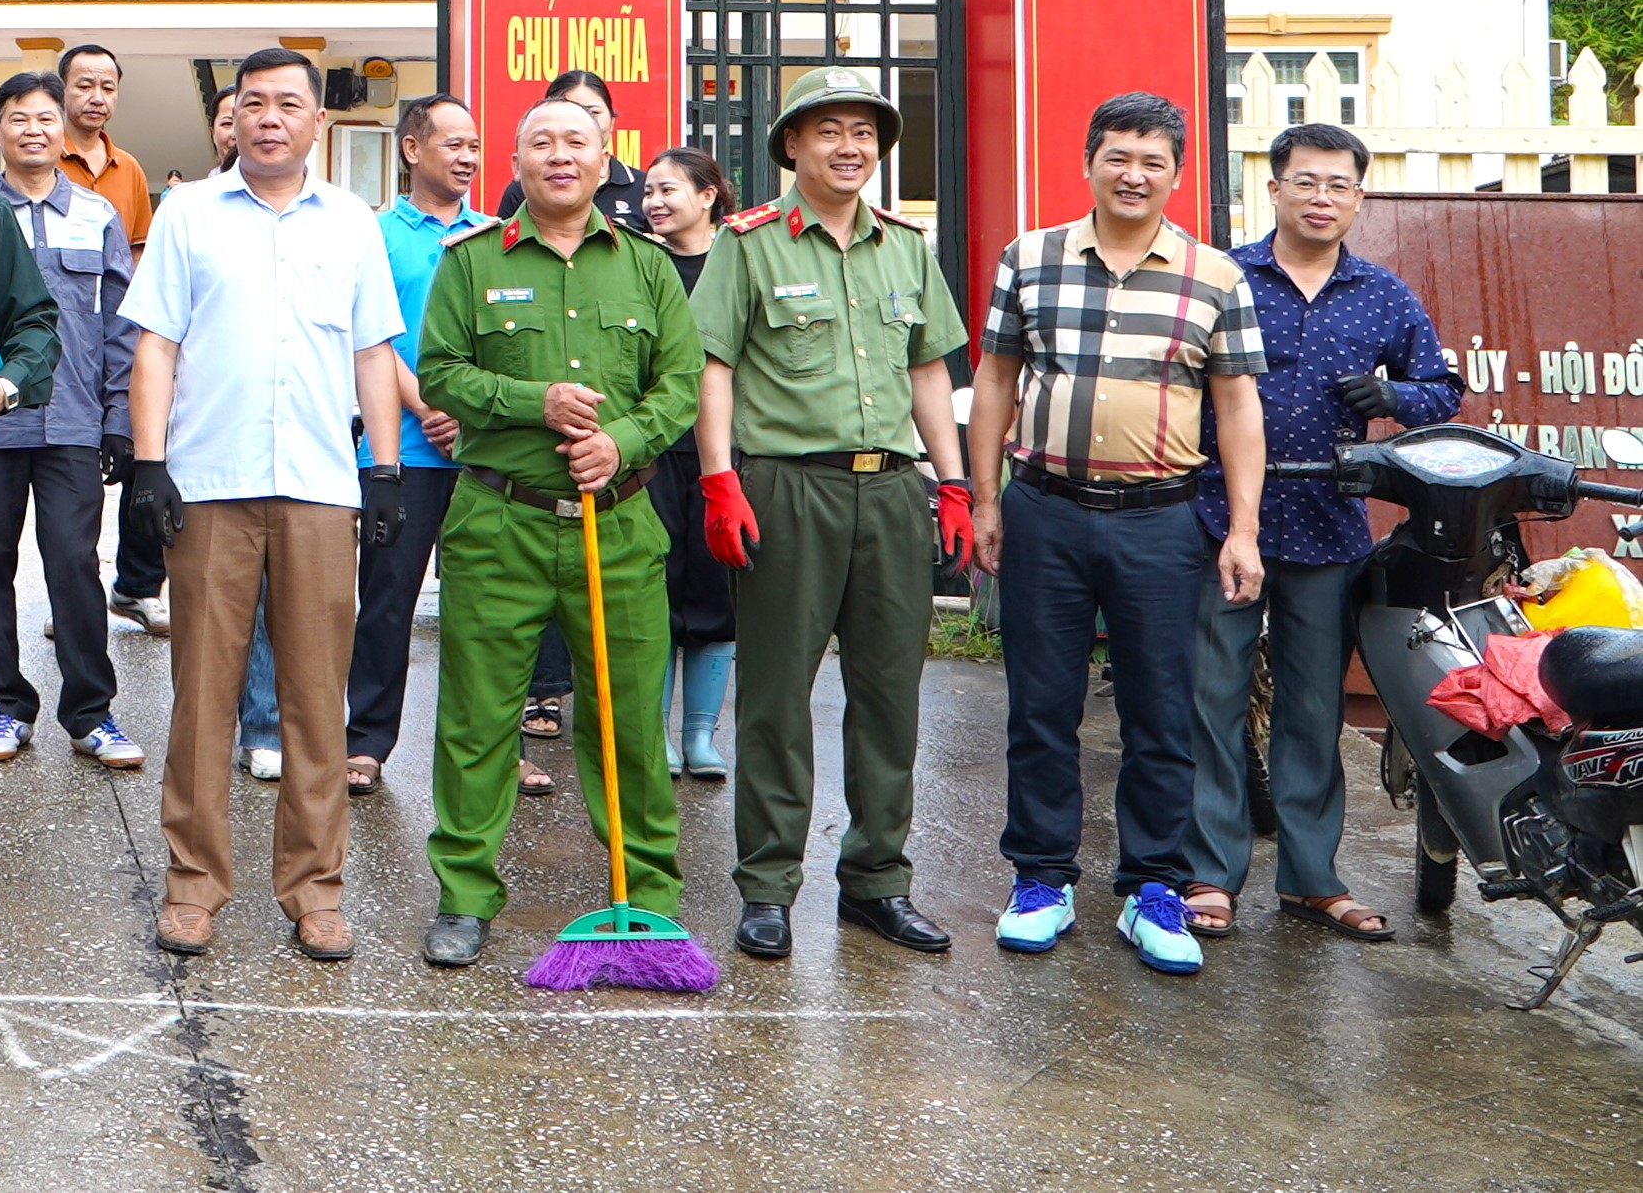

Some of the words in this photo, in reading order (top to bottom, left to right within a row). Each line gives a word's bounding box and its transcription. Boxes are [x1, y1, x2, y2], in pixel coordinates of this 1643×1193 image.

[568, 4, 649, 82] NGHĨA
[1466, 335, 1507, 393] ỦY
[1540, 341, 1596, 403] HỘI
[1538, 425, 1607, 469] BAN
